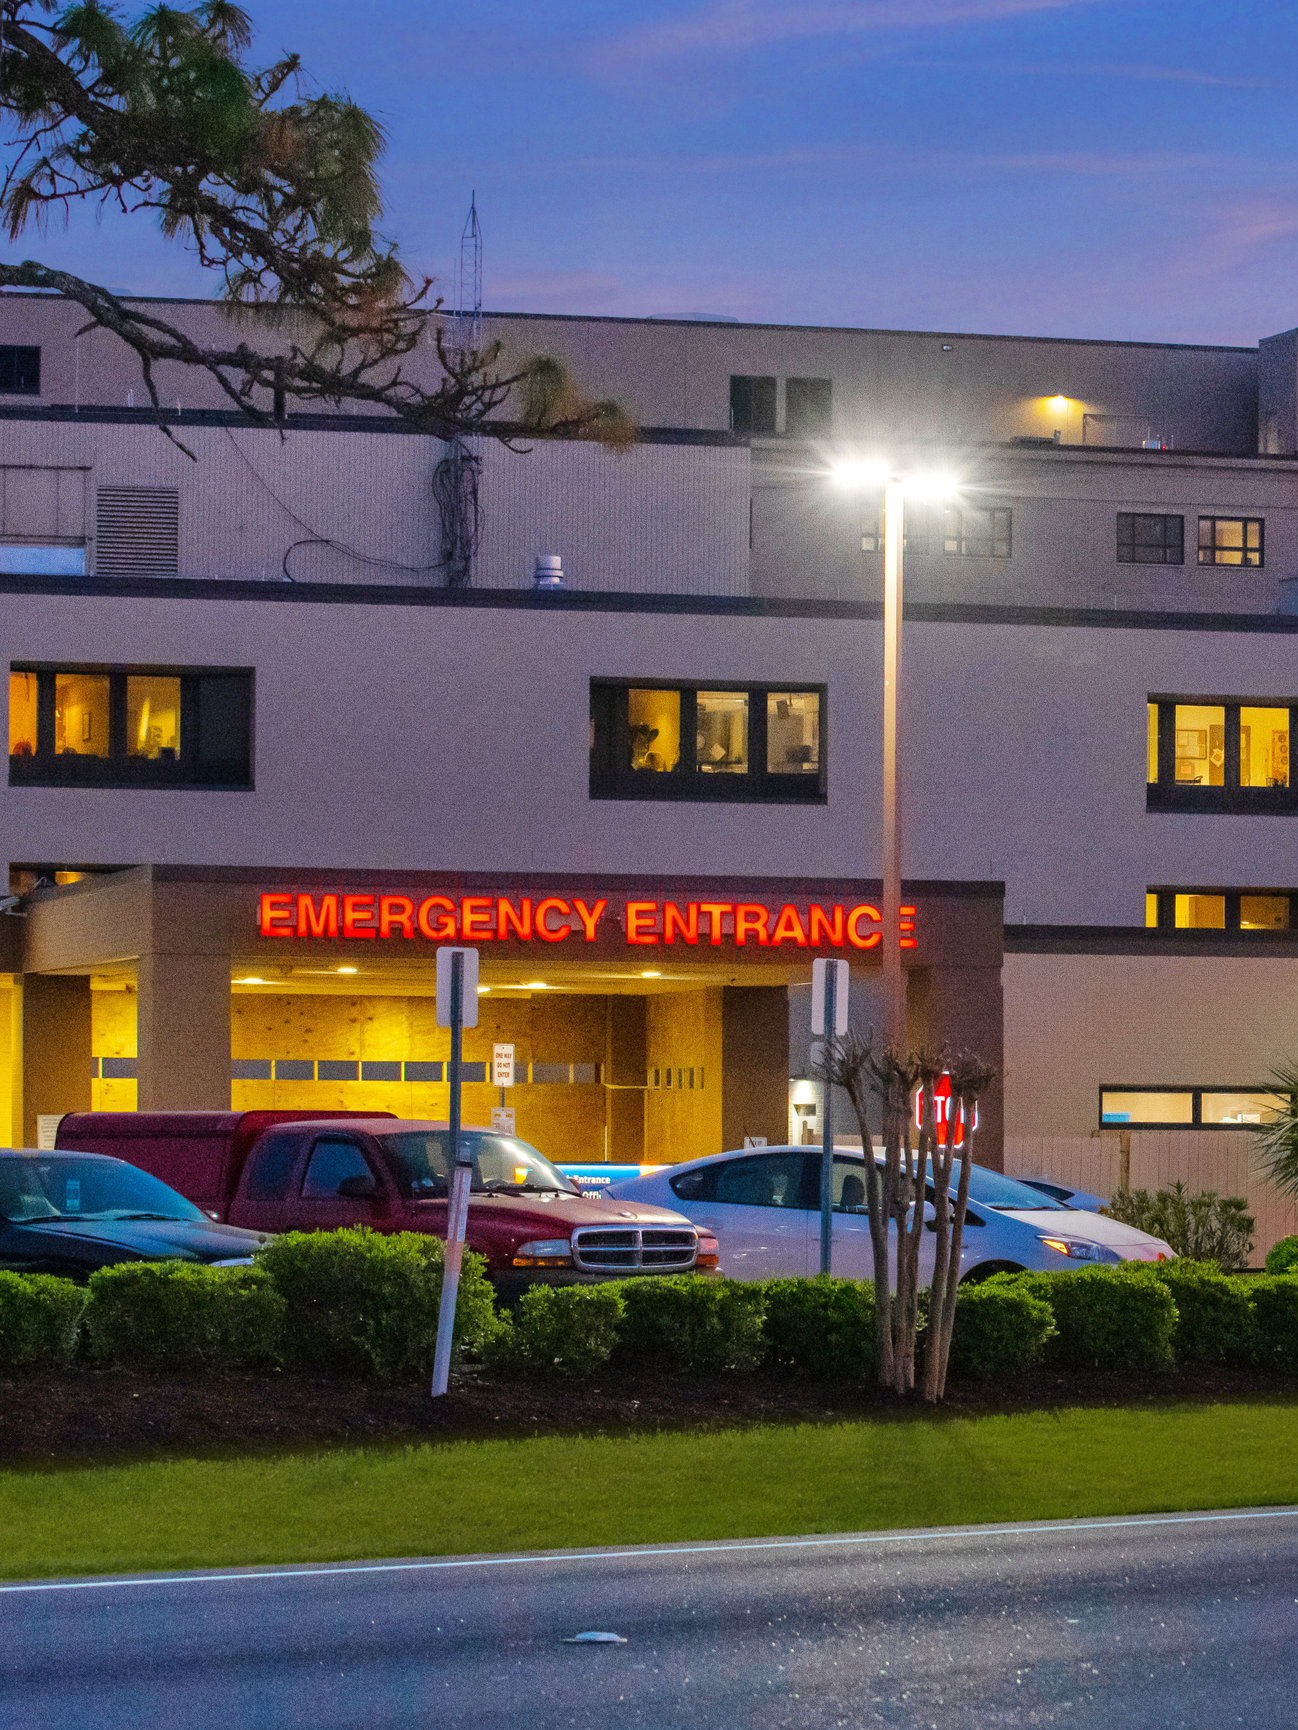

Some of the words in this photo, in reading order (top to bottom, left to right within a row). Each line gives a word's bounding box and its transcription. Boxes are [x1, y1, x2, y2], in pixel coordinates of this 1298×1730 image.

[259, 893, 608, 943] EMERGENCY
[625, 900, 917, 950] ENTRANCE
[573, 1174, 611, 1185] Entrance
[582, 1190, 602, 1200] Offi
